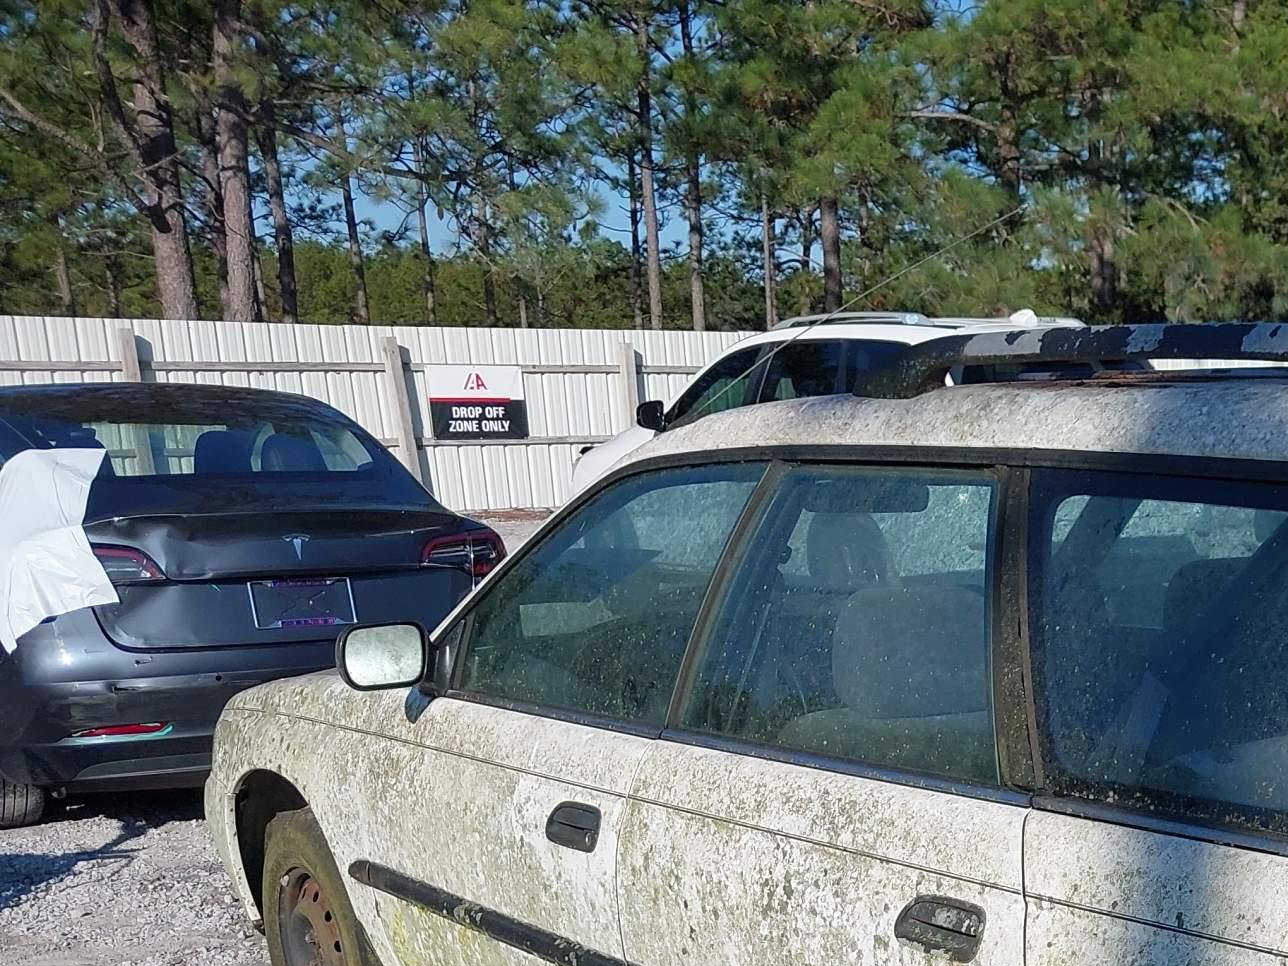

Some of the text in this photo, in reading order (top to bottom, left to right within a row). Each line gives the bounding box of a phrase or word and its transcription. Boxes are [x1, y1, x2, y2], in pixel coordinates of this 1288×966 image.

[451, 406, 505, 419] DROP OFF
[448, 420, 511, 433] ZONE ONLY
